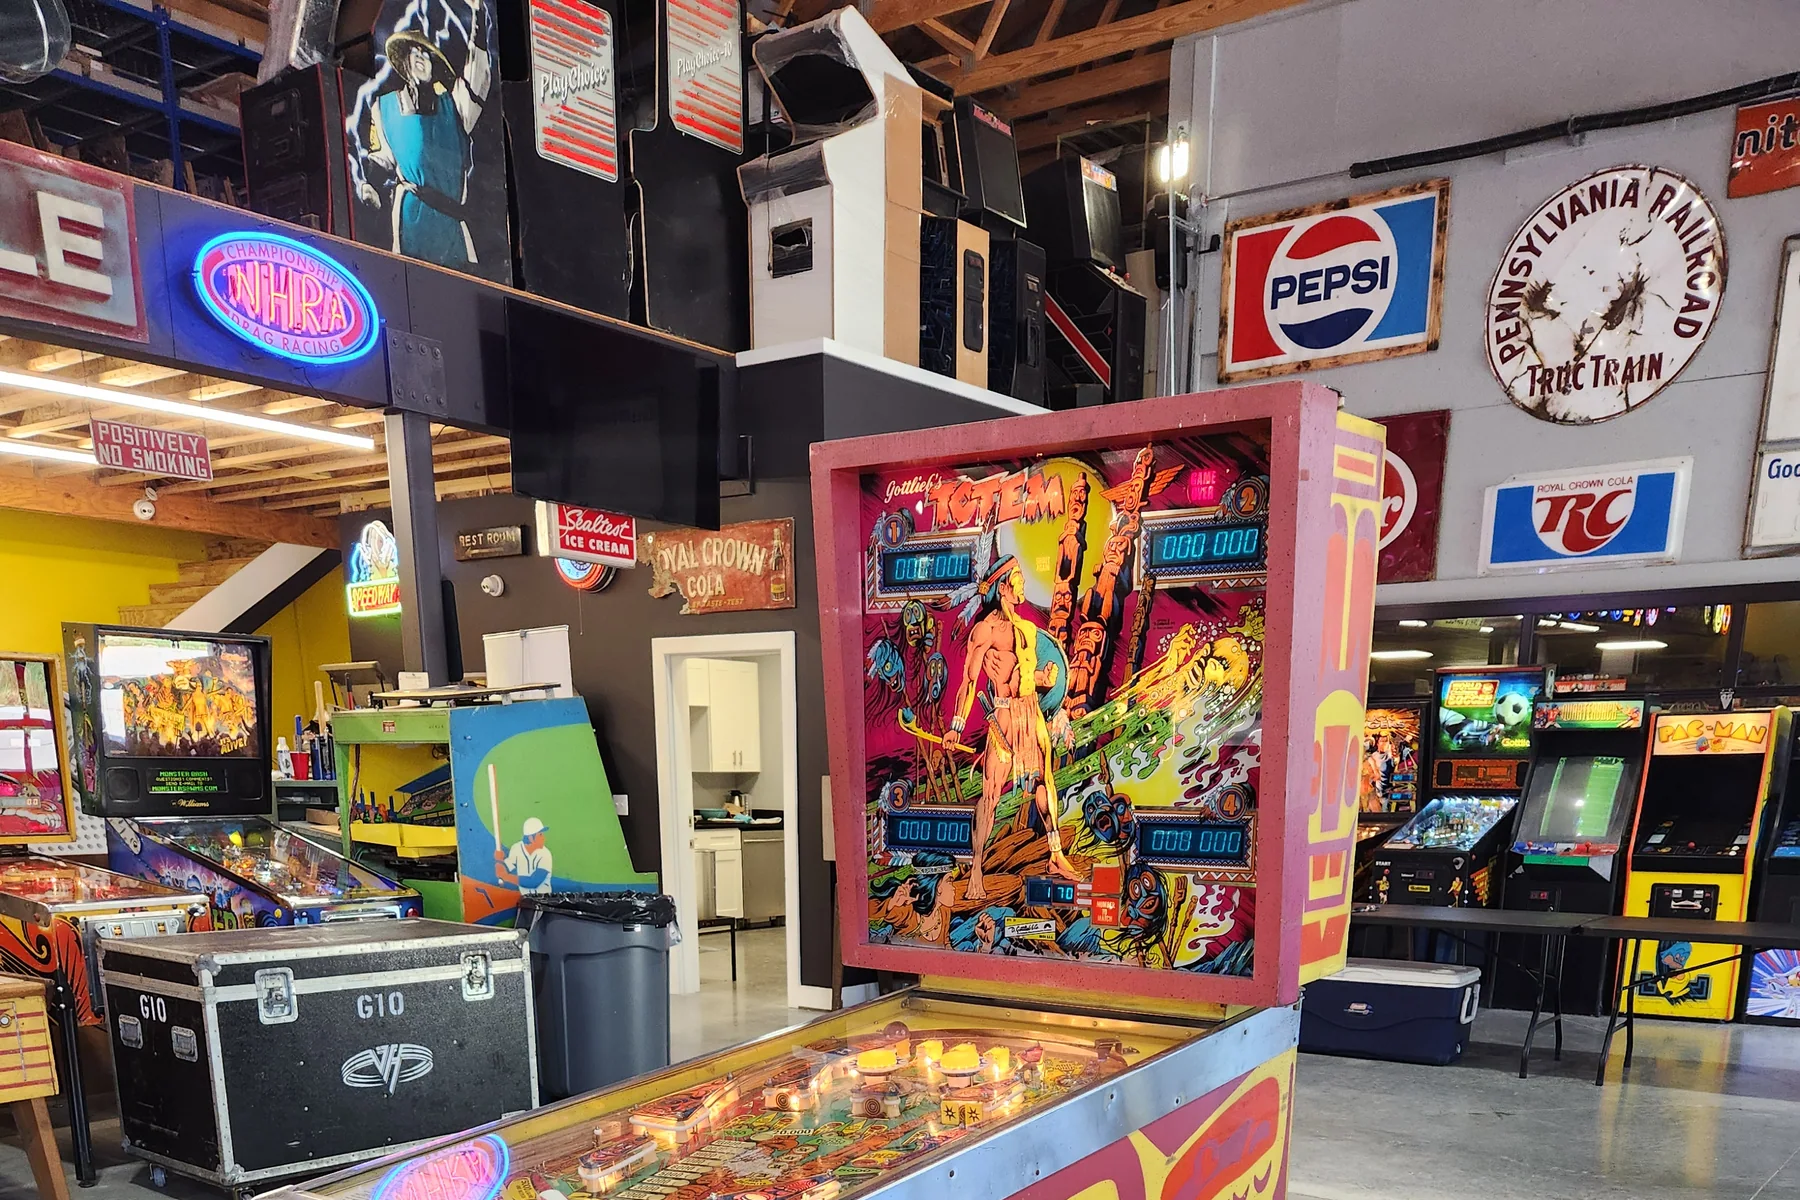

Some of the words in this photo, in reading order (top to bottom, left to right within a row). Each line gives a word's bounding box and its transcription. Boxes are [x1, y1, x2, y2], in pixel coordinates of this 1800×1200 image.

[540, 62, 607, 103] PlayChoice
[225, 242, 339, 287] CHAMPIONSHIP
[1495, 178, 1641, 365] PENNSYLVANIA
[1650, 183, 1717, 339] RAILROAD
[227, 260, 347, 336] NHRA
[1270, 255, 1390, 311] PEPSI
[231, 312, 274, 344] DRAG
[282, 336, 341, 355] RACING
[98, 421, 200, 456] POSITIVELY
[98, 443, 123, 468] NO
[131, 446, 209, 478] SMOKING
[884, 472, 943, 504] Gottlieb's
[1190, 470, 1217, 486] GAME
[1537, 483, 1566, 494] ROYAL
[1569, 479, 1604, 491] CROWN
[1608, 475, 1634, 487] COLA
[927, 468, 1066, 530] TOTEM
[1240, 486, 1255, 513] 2
[564, 508, 630, 540] Sealtest
[889, 521, 898, 543] 1
[1535, 488, 1632, 553] RC
[565, 534, 584, 549] ICE
[588, 537, 630, 556] CREAM
[702, 537, 768, 576] CROWN
[1162, 532, 1207, 560] 000
[1213, 528, 1260, 557] 000
[687, 574, 726, 599] COLA
[1658, 719, 1768, 744] PAC-MAN
[893, 787, 904, 807] 3
[1222, 794, 1238, 815] 4
[899, 820, 931, 841] 000
[936, 821, 970, 843] 000
[1199, 831, 1242, 853] 000
[1057, 886, 1074, 900] 70
